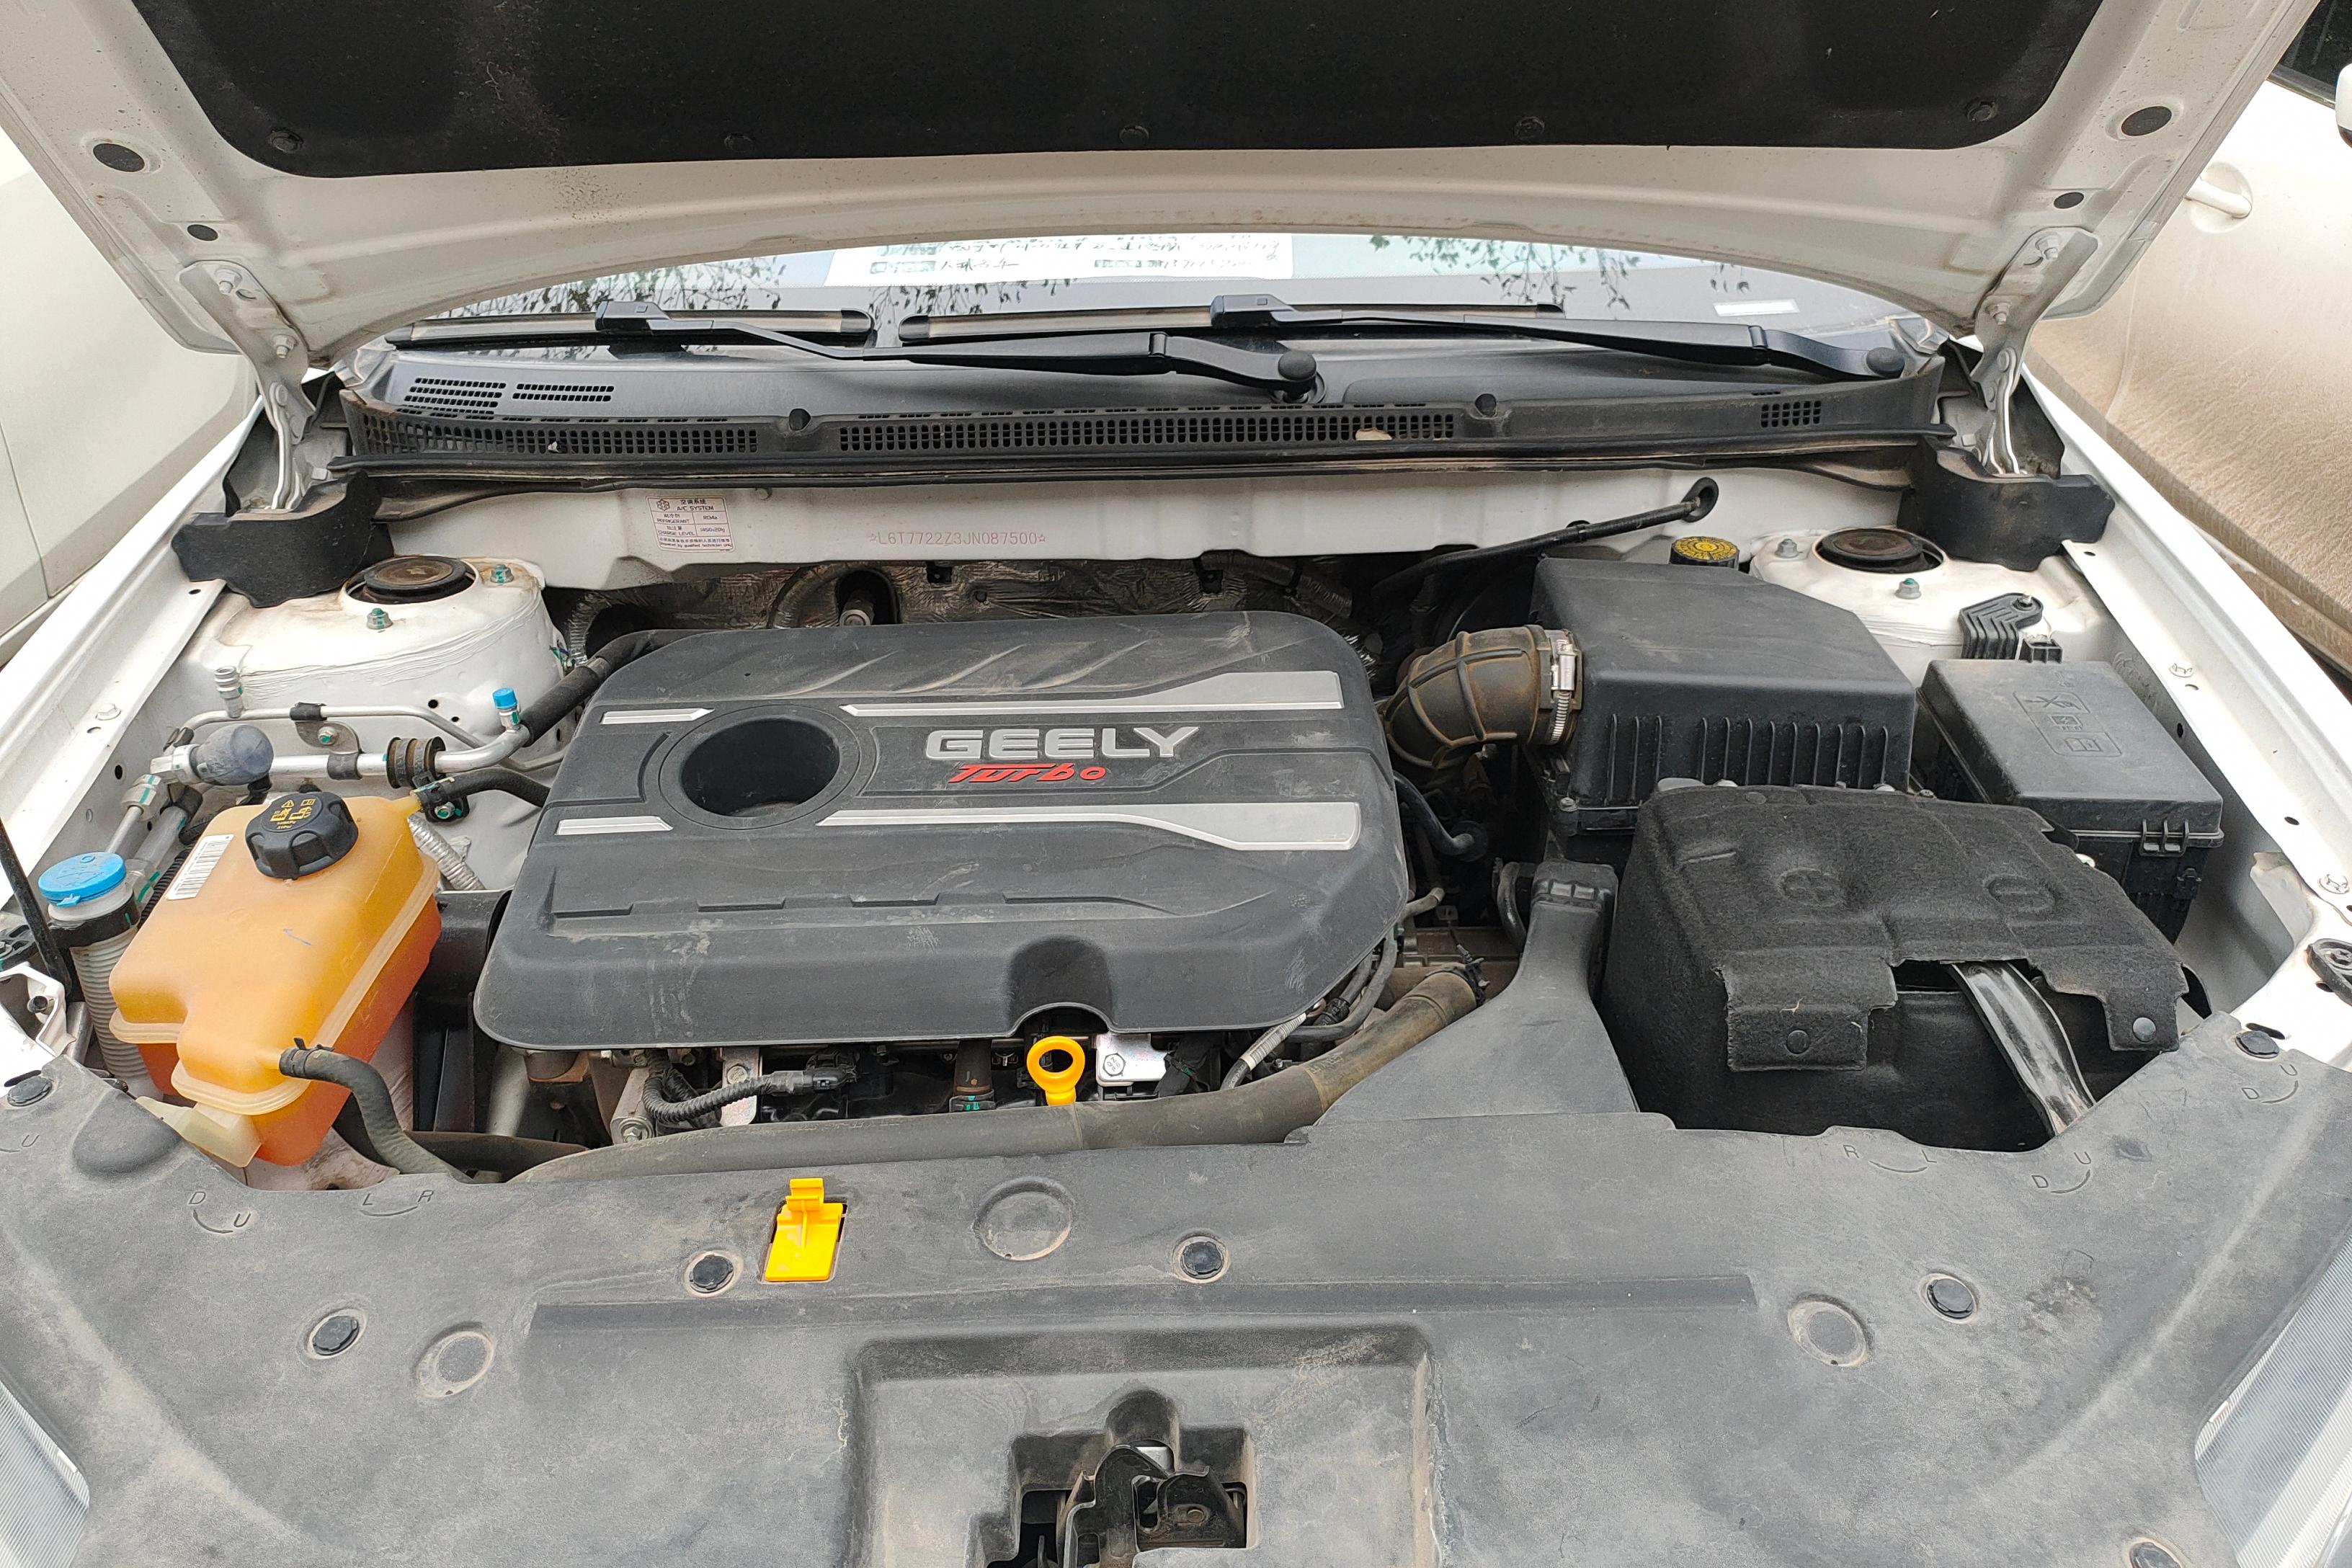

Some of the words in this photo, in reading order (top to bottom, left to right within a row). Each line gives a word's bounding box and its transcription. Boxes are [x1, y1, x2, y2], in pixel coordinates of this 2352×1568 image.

[925, 726, 1200, 759] GEELY
[2241, 1087, 2259, 1099] D
[21, 1134, 40, 1147] U
[1843, 1144, 1860, 1158] R
[1920, 1149, 1938, 1164] L
[2073, 1151, 2092, 1164] U
[2031, 1175, 2049, 1188] D
[188, 1190, 206, 1204] D
[362, 1193, 373, 1206] L
[417, 1190, 434, 1203] R
[233, 1213, 251, 1227] U
